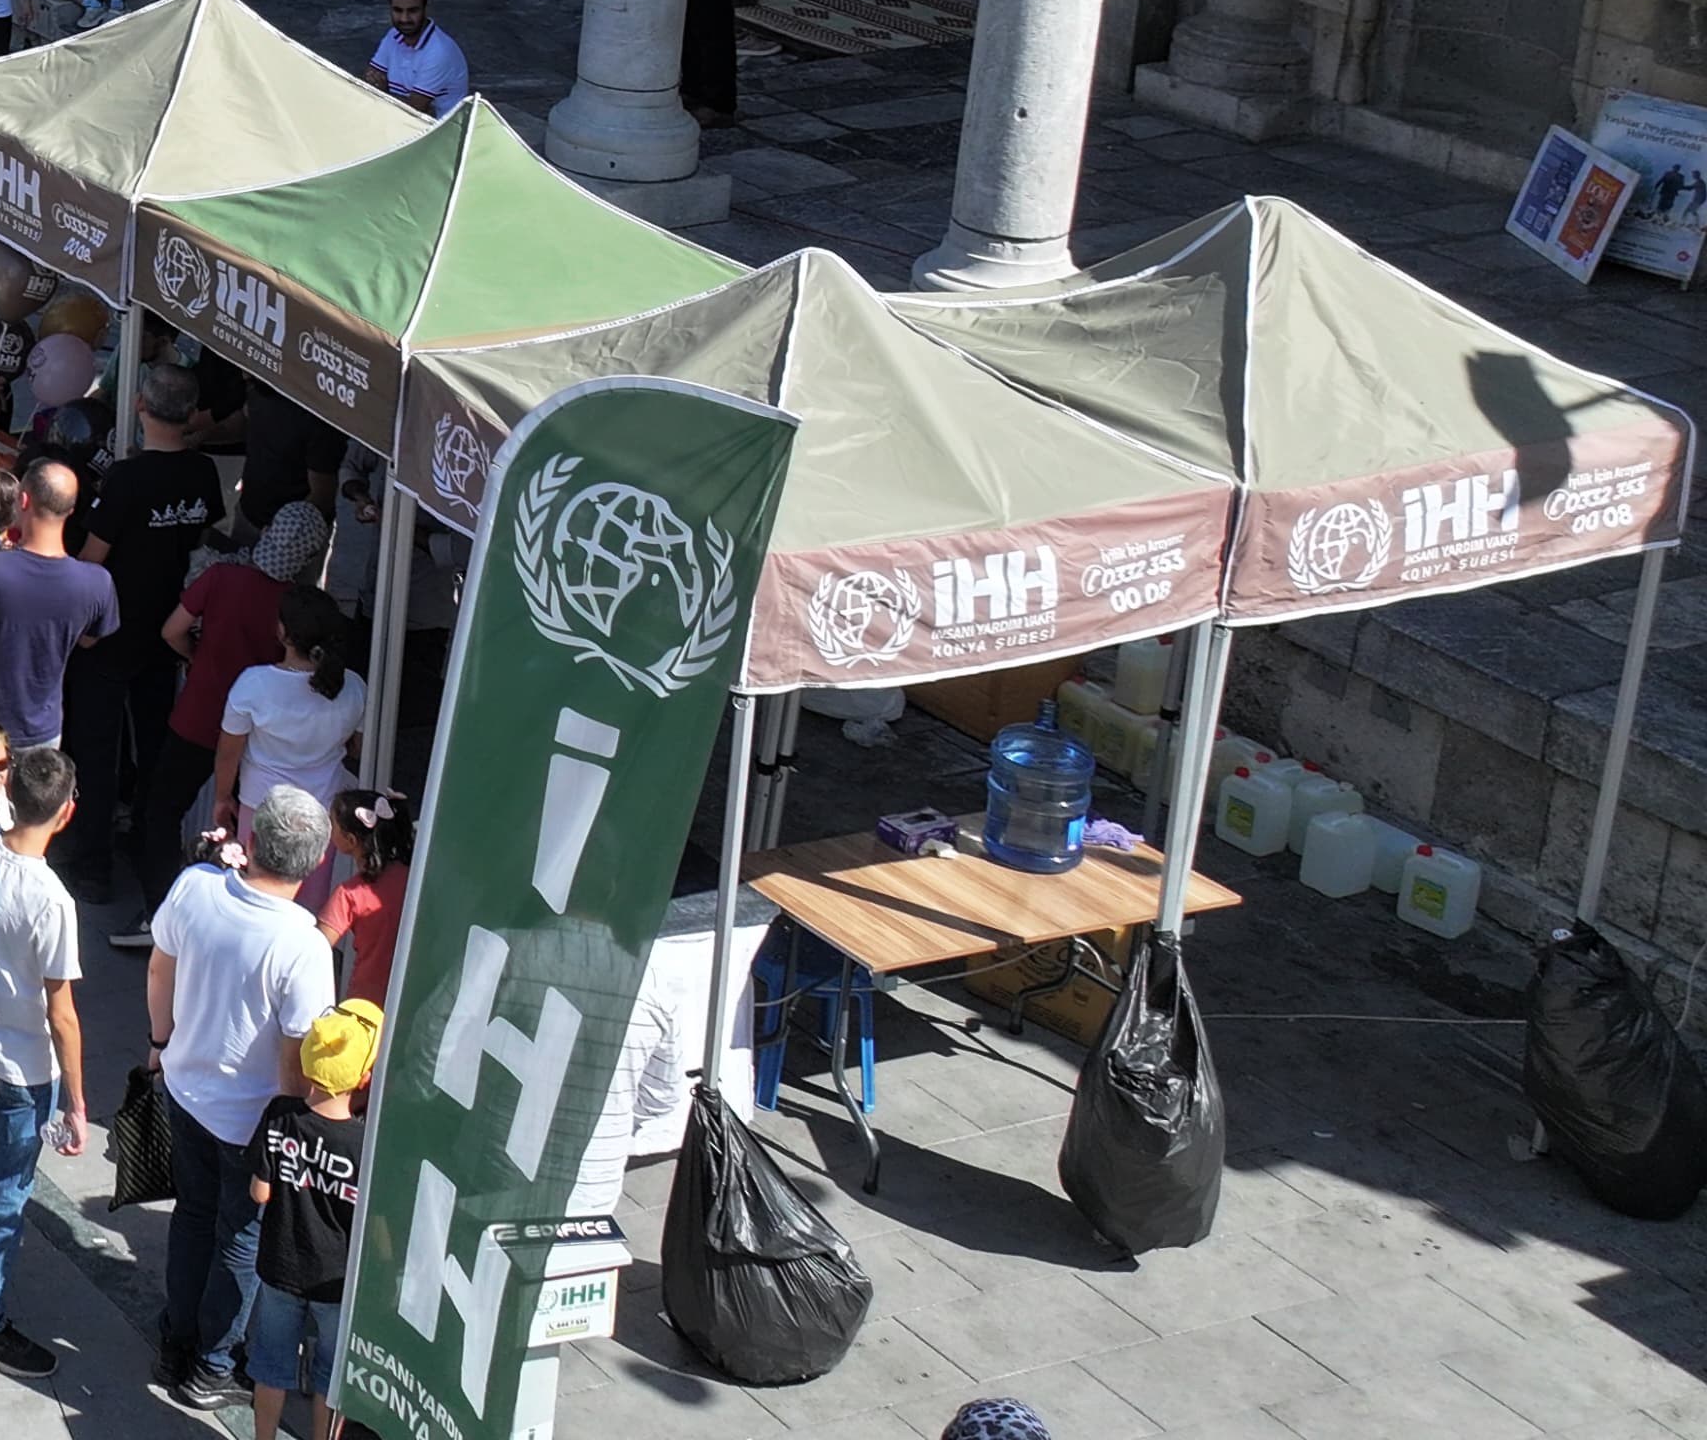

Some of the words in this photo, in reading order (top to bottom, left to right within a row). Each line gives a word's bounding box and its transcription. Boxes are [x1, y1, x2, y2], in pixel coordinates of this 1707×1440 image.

[214, 259, 287, 348] iHH
[212, 325, 243, 351] KONYA
[311, 344, 344, 377] 0332
[344, 361, 370, 391] 353
[316, 371, 335, 397] 00
[336, 383, 356, 409] 08
[1402, 468, 1520, 553] iHH
[1565, 487, 1612, 514] 0332
[1612, 475, 1647, 500] 353
[1572, 512, 1602, 535] 00
[1601, 504, 1634, 530] 08
[1440, 539, 1485, 560] YARDIM
[1484, 532, 1520, 553] VAKFI
[932, 544, 1059, 628] iHH
[1101, 559, 1145, 590] 0332
[1145, 548, 1187, 578] 353
[1400, 562, 1451, 583] KONYA
[1110, 587, 1141, 614] 00
[1142, 580, 1173, 609] 08
[976, 617, 1024, 636] YARDIM
[1023, 610, 1057, 628] VAKFI
[931, 636, 987, 659] KONYA
[524, 1220, 613, 1239] EDIFICE
[561, 1281, 607, 1307] iHH
[350, 1332, 415, 1393] İNSANİ
[345, 1360, 430, 1440] KONYA
